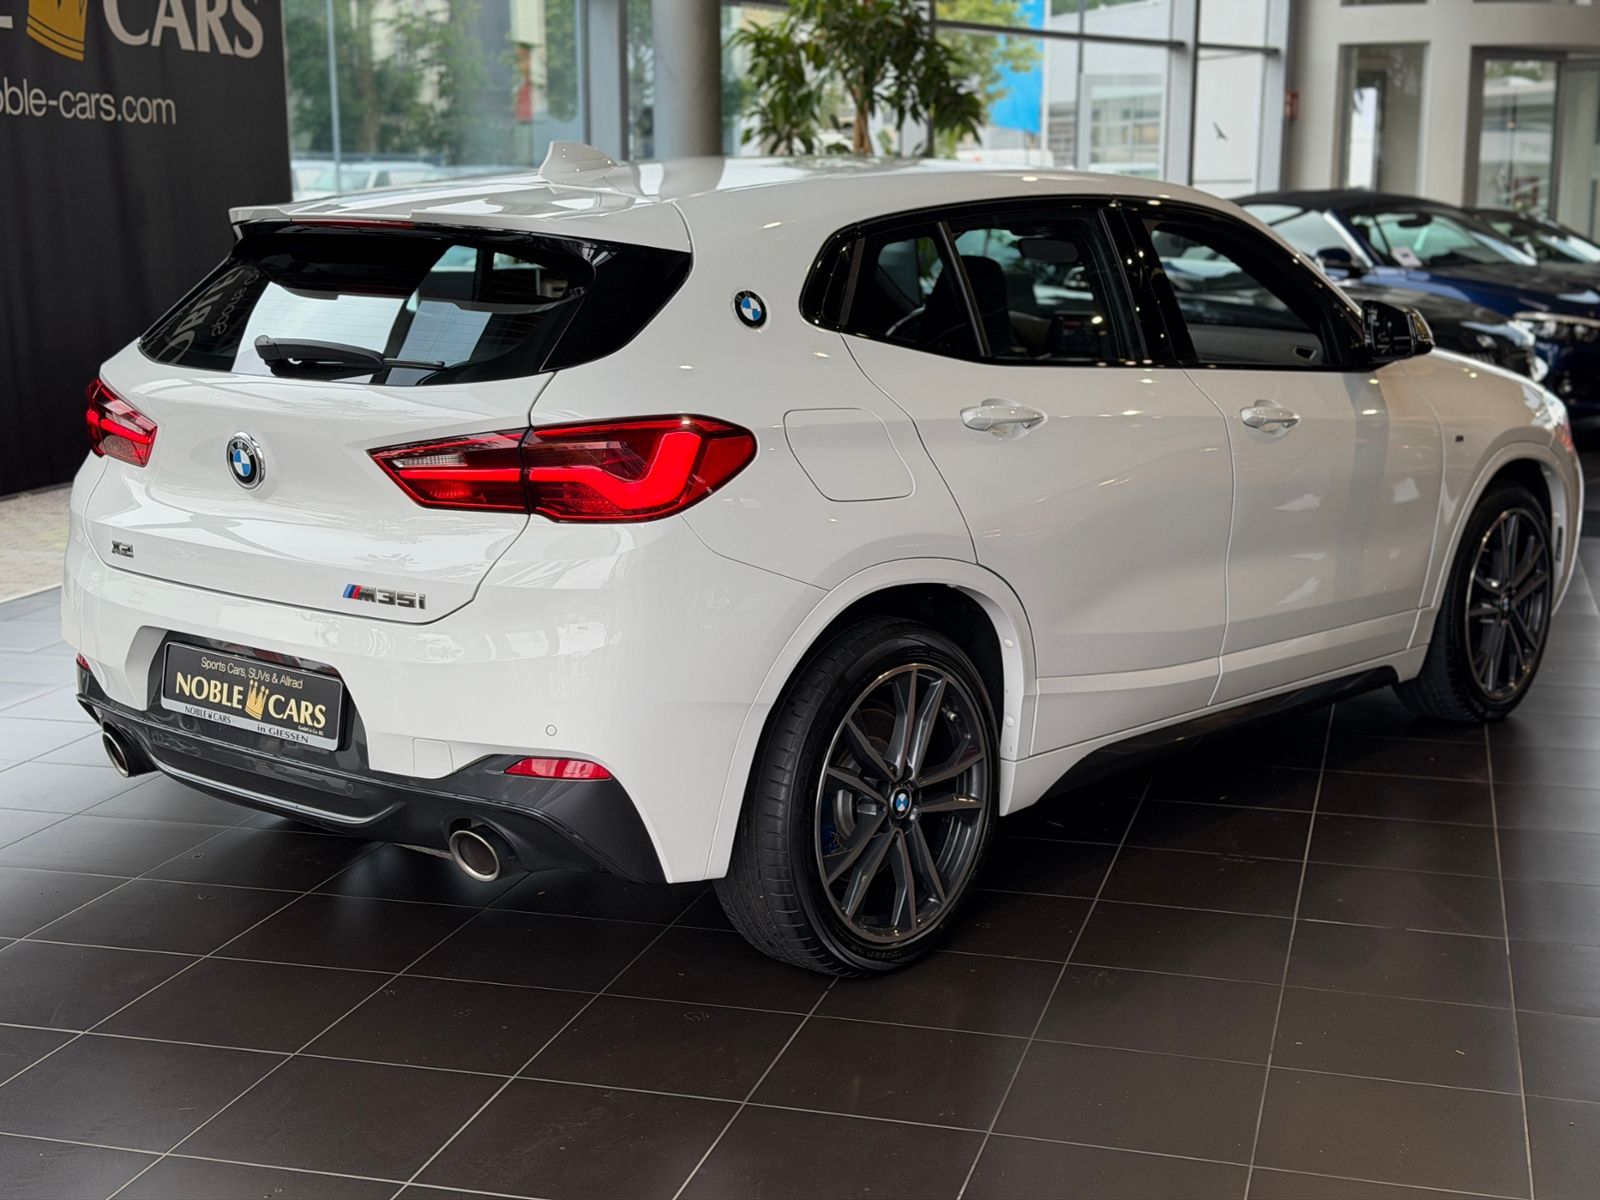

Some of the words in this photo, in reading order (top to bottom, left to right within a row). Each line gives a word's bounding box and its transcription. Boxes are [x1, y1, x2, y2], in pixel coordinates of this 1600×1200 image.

[103, 0, 264, 58] CARS
[0, 77, 176, 125] ble-cars.com
[111, 540, 135, 558] X2
[357, 585, 426, 610] M35i
[201, 656, 226, 672] Sports
[227, 663, 246, 679] Cars,
[248, 667, 271, 682] SUVs
[271, 673, 279, 685] &
[279, 675, 303, 690] Allrad
[175, 671, 244, 709] NOBLE
[268, 694, 327, 728] CARS
[184, 705, 207, 718] NOBLE
[213, 712, 232, 724] CARS
[257, 724, 266, 732] in
[268, 725, 309, 744] GIESSEN
